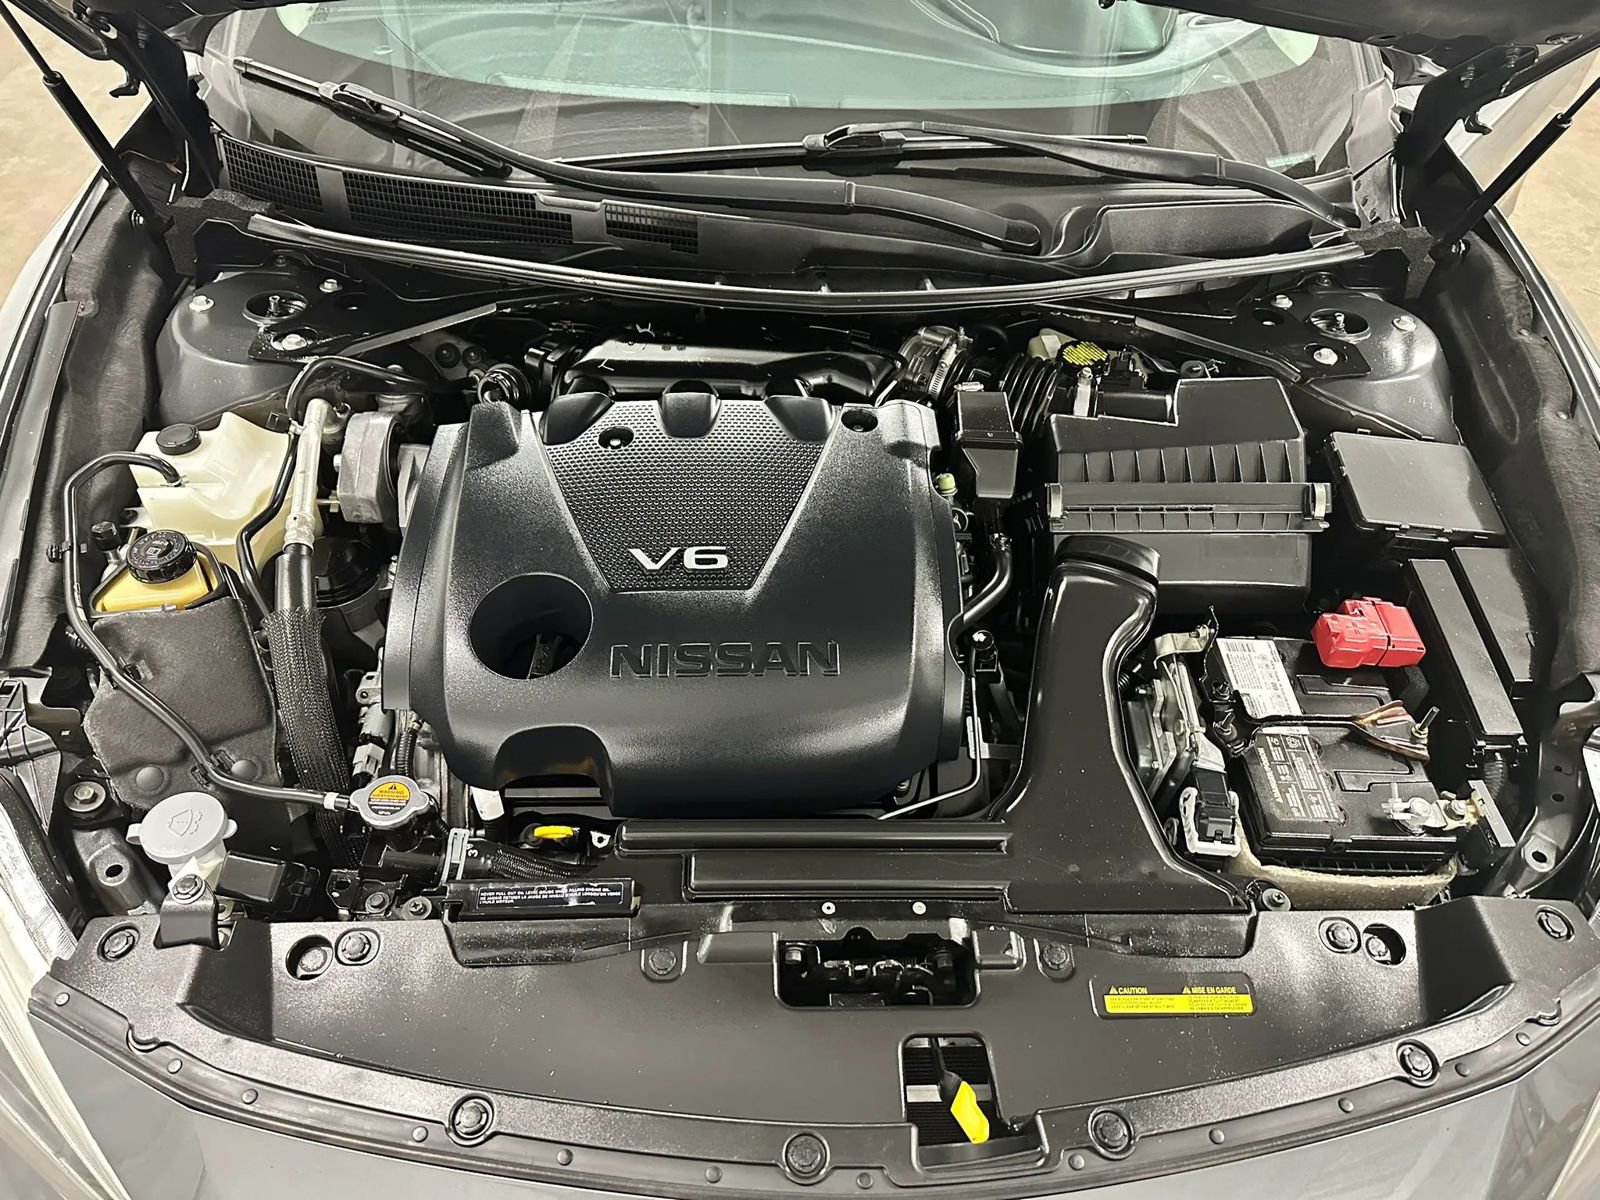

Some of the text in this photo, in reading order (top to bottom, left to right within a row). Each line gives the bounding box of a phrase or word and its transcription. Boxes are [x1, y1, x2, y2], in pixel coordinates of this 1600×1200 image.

[627, 546, 729, 571] V6
[610, 641, 841, 679] NISSAN
[1118, 986, 1148, 994] CAUTION
[1191, 986, 1237, 994] MISE EN GARDE
